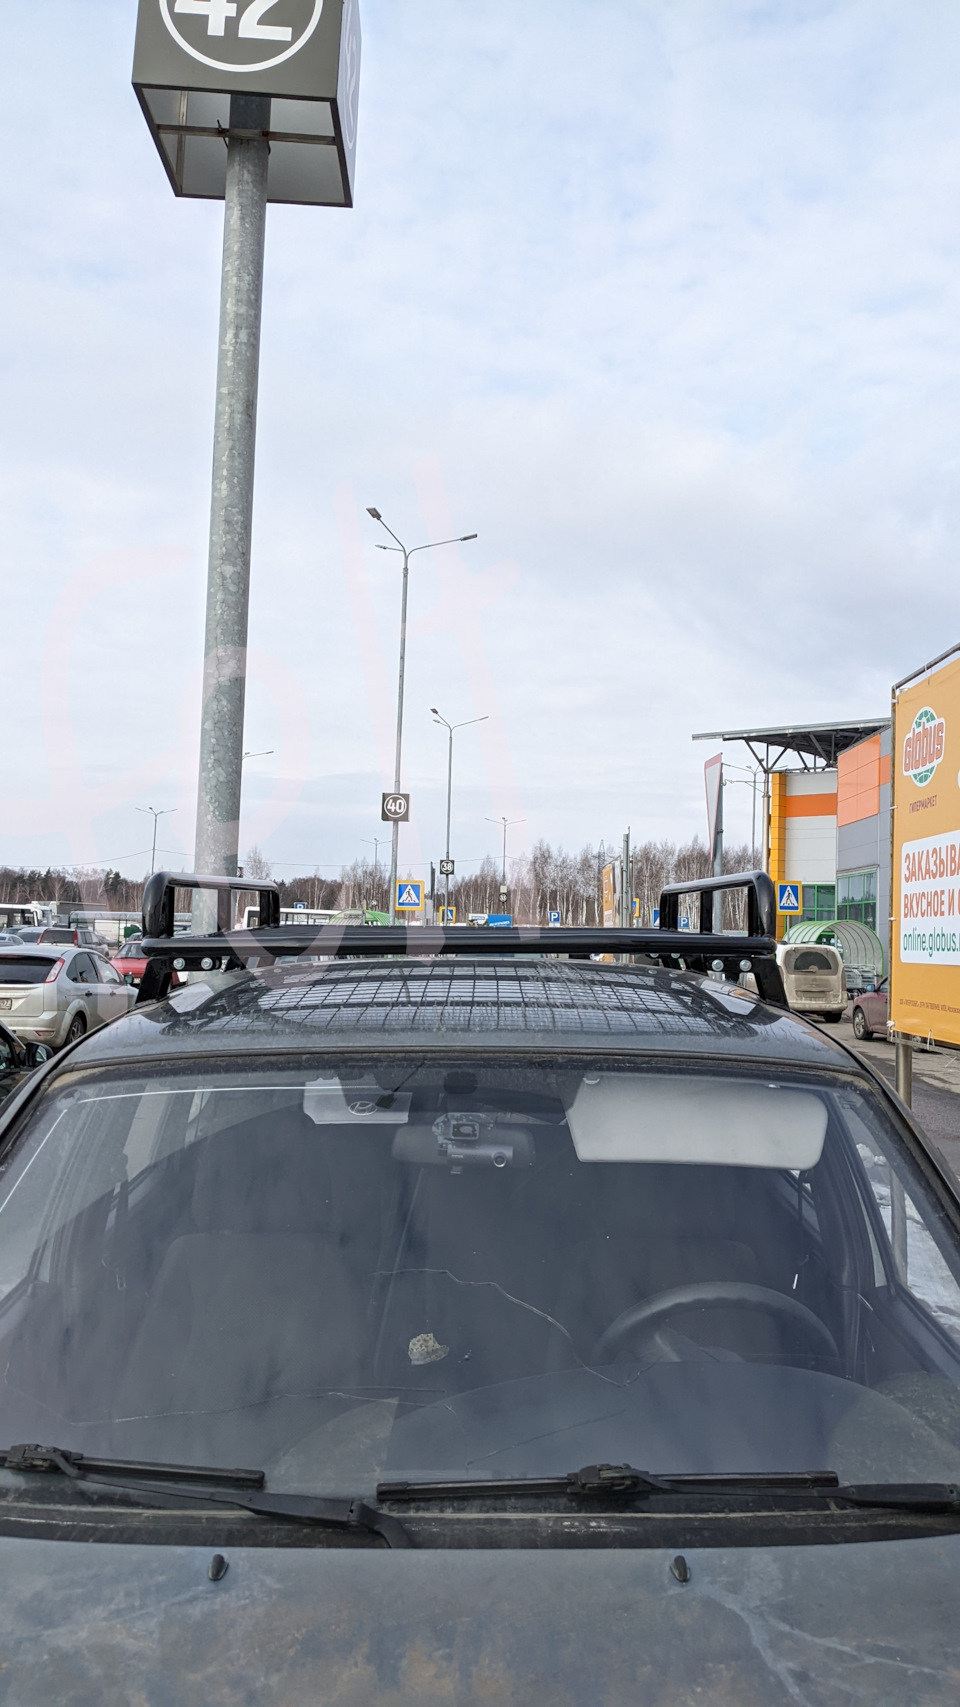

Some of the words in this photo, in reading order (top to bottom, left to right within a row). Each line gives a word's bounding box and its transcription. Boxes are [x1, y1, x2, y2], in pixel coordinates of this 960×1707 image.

[387, 799, 405, 813] 40
[442, 863, 452, 871] 38
[904, 890, 945, 918] ВКУСНОЕ
[948, 889, 955, 916] И
[551, 912, 558, 921] P
[681, 918, 688, 926] P
